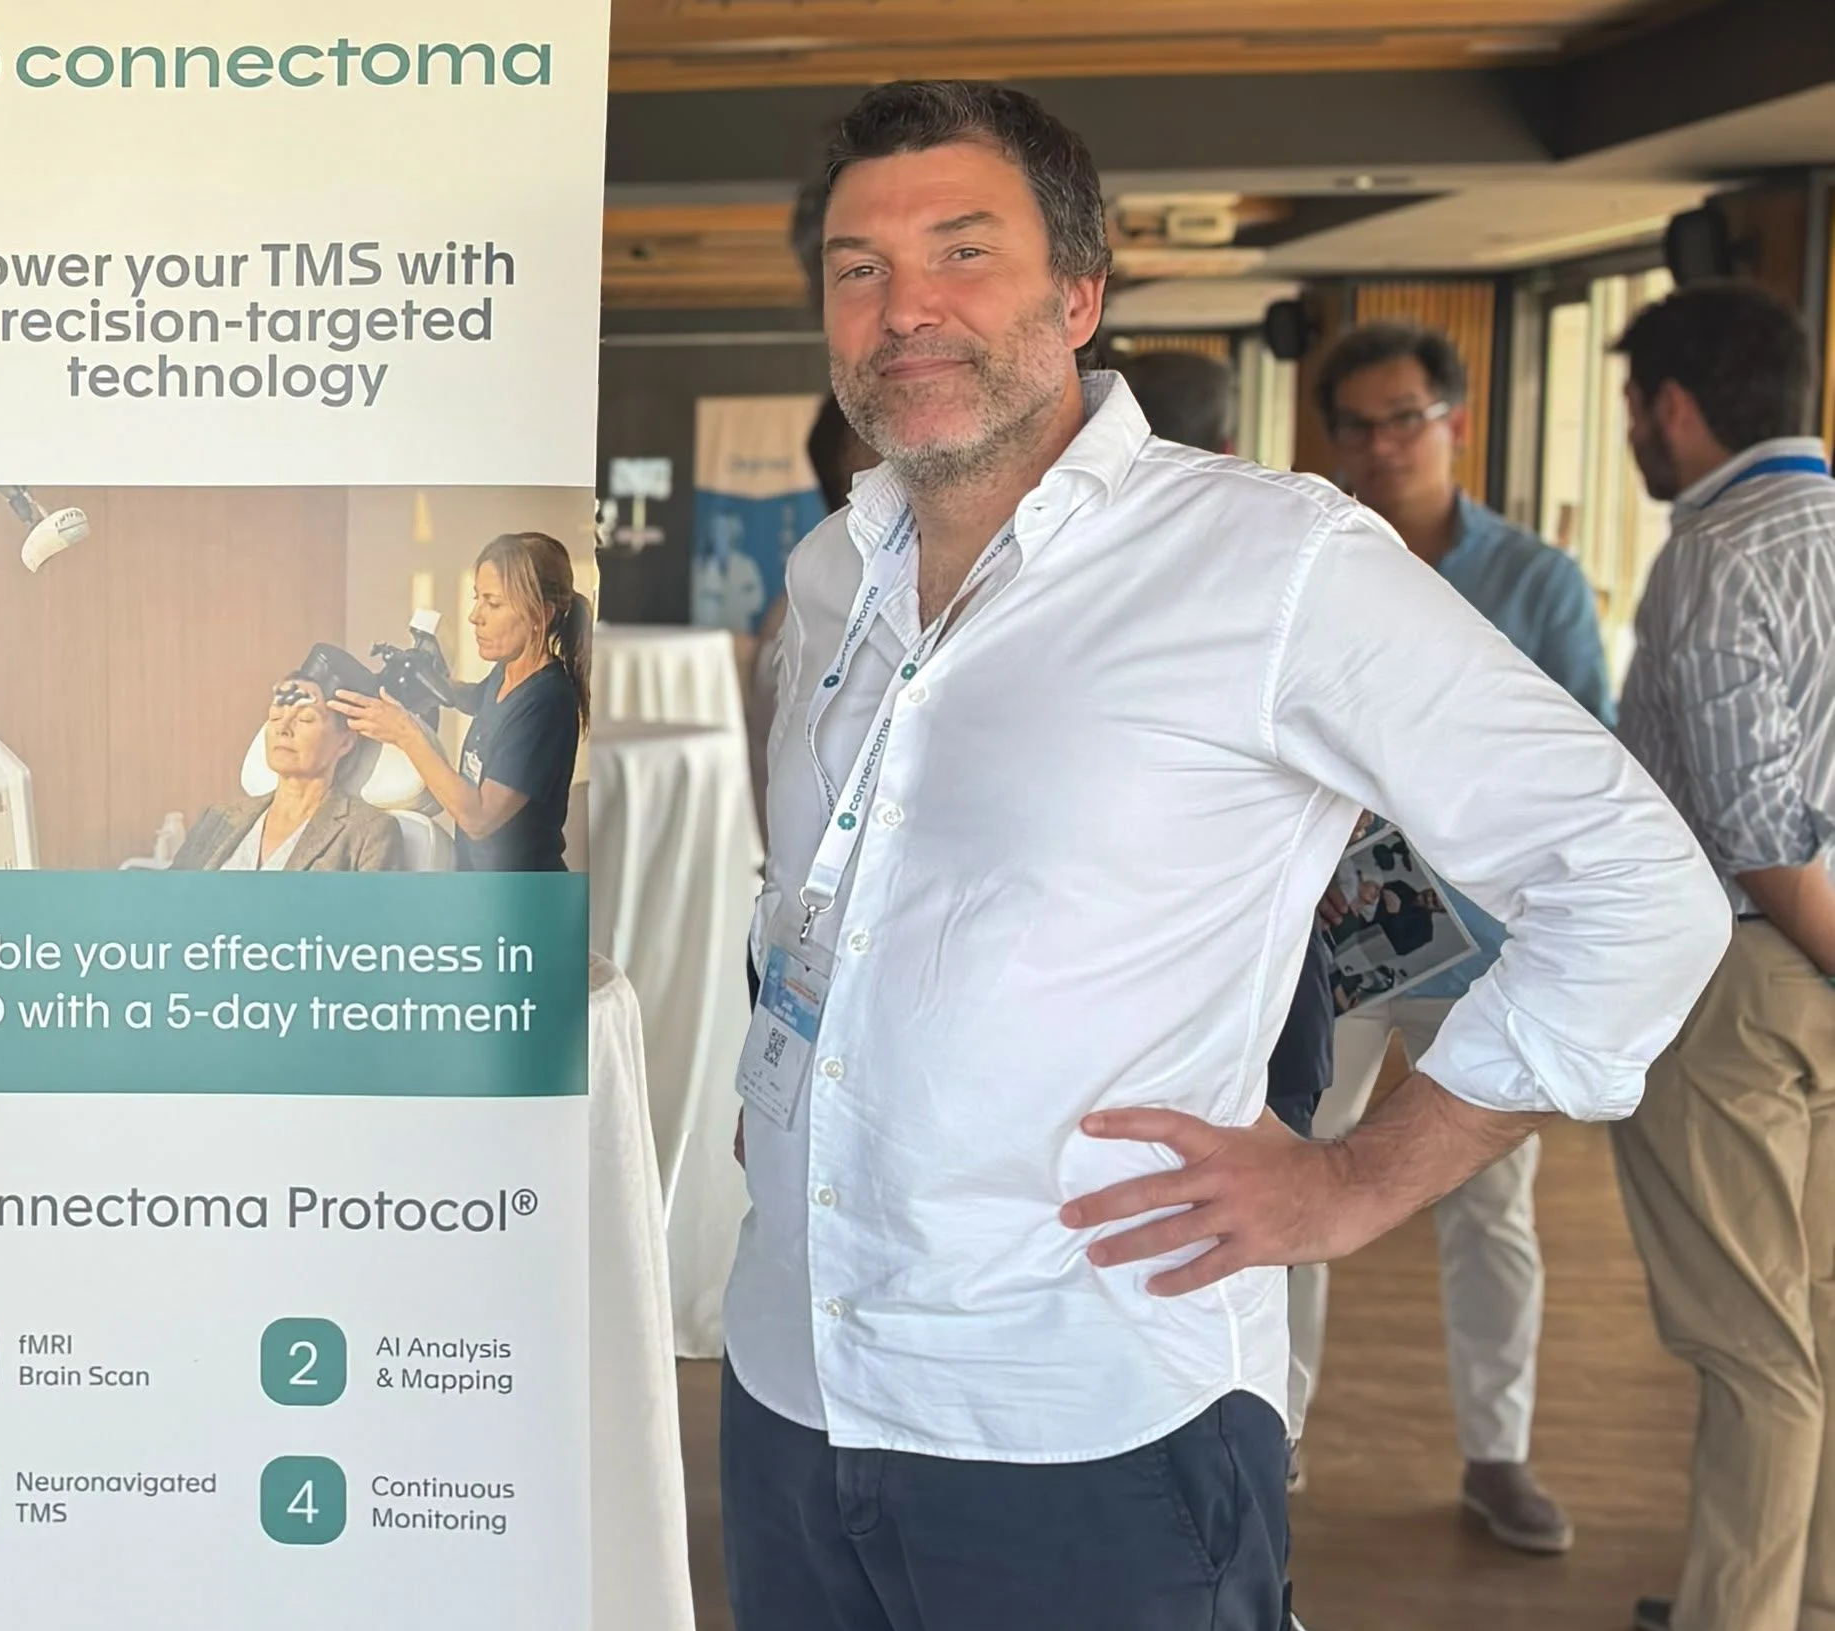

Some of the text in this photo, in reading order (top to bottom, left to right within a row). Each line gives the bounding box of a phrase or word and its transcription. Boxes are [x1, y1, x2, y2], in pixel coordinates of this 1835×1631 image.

[15, 38, 551, 89] connectoma
[124, 254, 249, 298] your
[260, 241, 382, 287] TMS
[397, 240, 515, 285] with
[67, 354, 389, 408] technology
[73, 942, 173, 978] your
[183, 934, 483, 973] effectiveness
[497, 936, 533, 973] in
[17, 992, 109, 1028] with
[124, 1001, 152, 1029] a
[166, 993, 298, 1038] 5-day
[309, 996, 537, 1032] treatment
[18, 1334, 72, 1355] fMRI
[376, 1335, 512, 1362] AI Analysis
[19, 1365, 150, 1387] Brain Scan
[289, 1340, 318, 1385] 2
[376, 1367, 513, 1395] & Mapping
[16, 1471, 217, 1497] Neuronavigated
[371, 1475, 515, 1499] Continuous
[15, 1502, 68, 1523] TMS
[286, 1479, 319, 1524] 4
[372, 1507, 507, 1536] Monitoring
